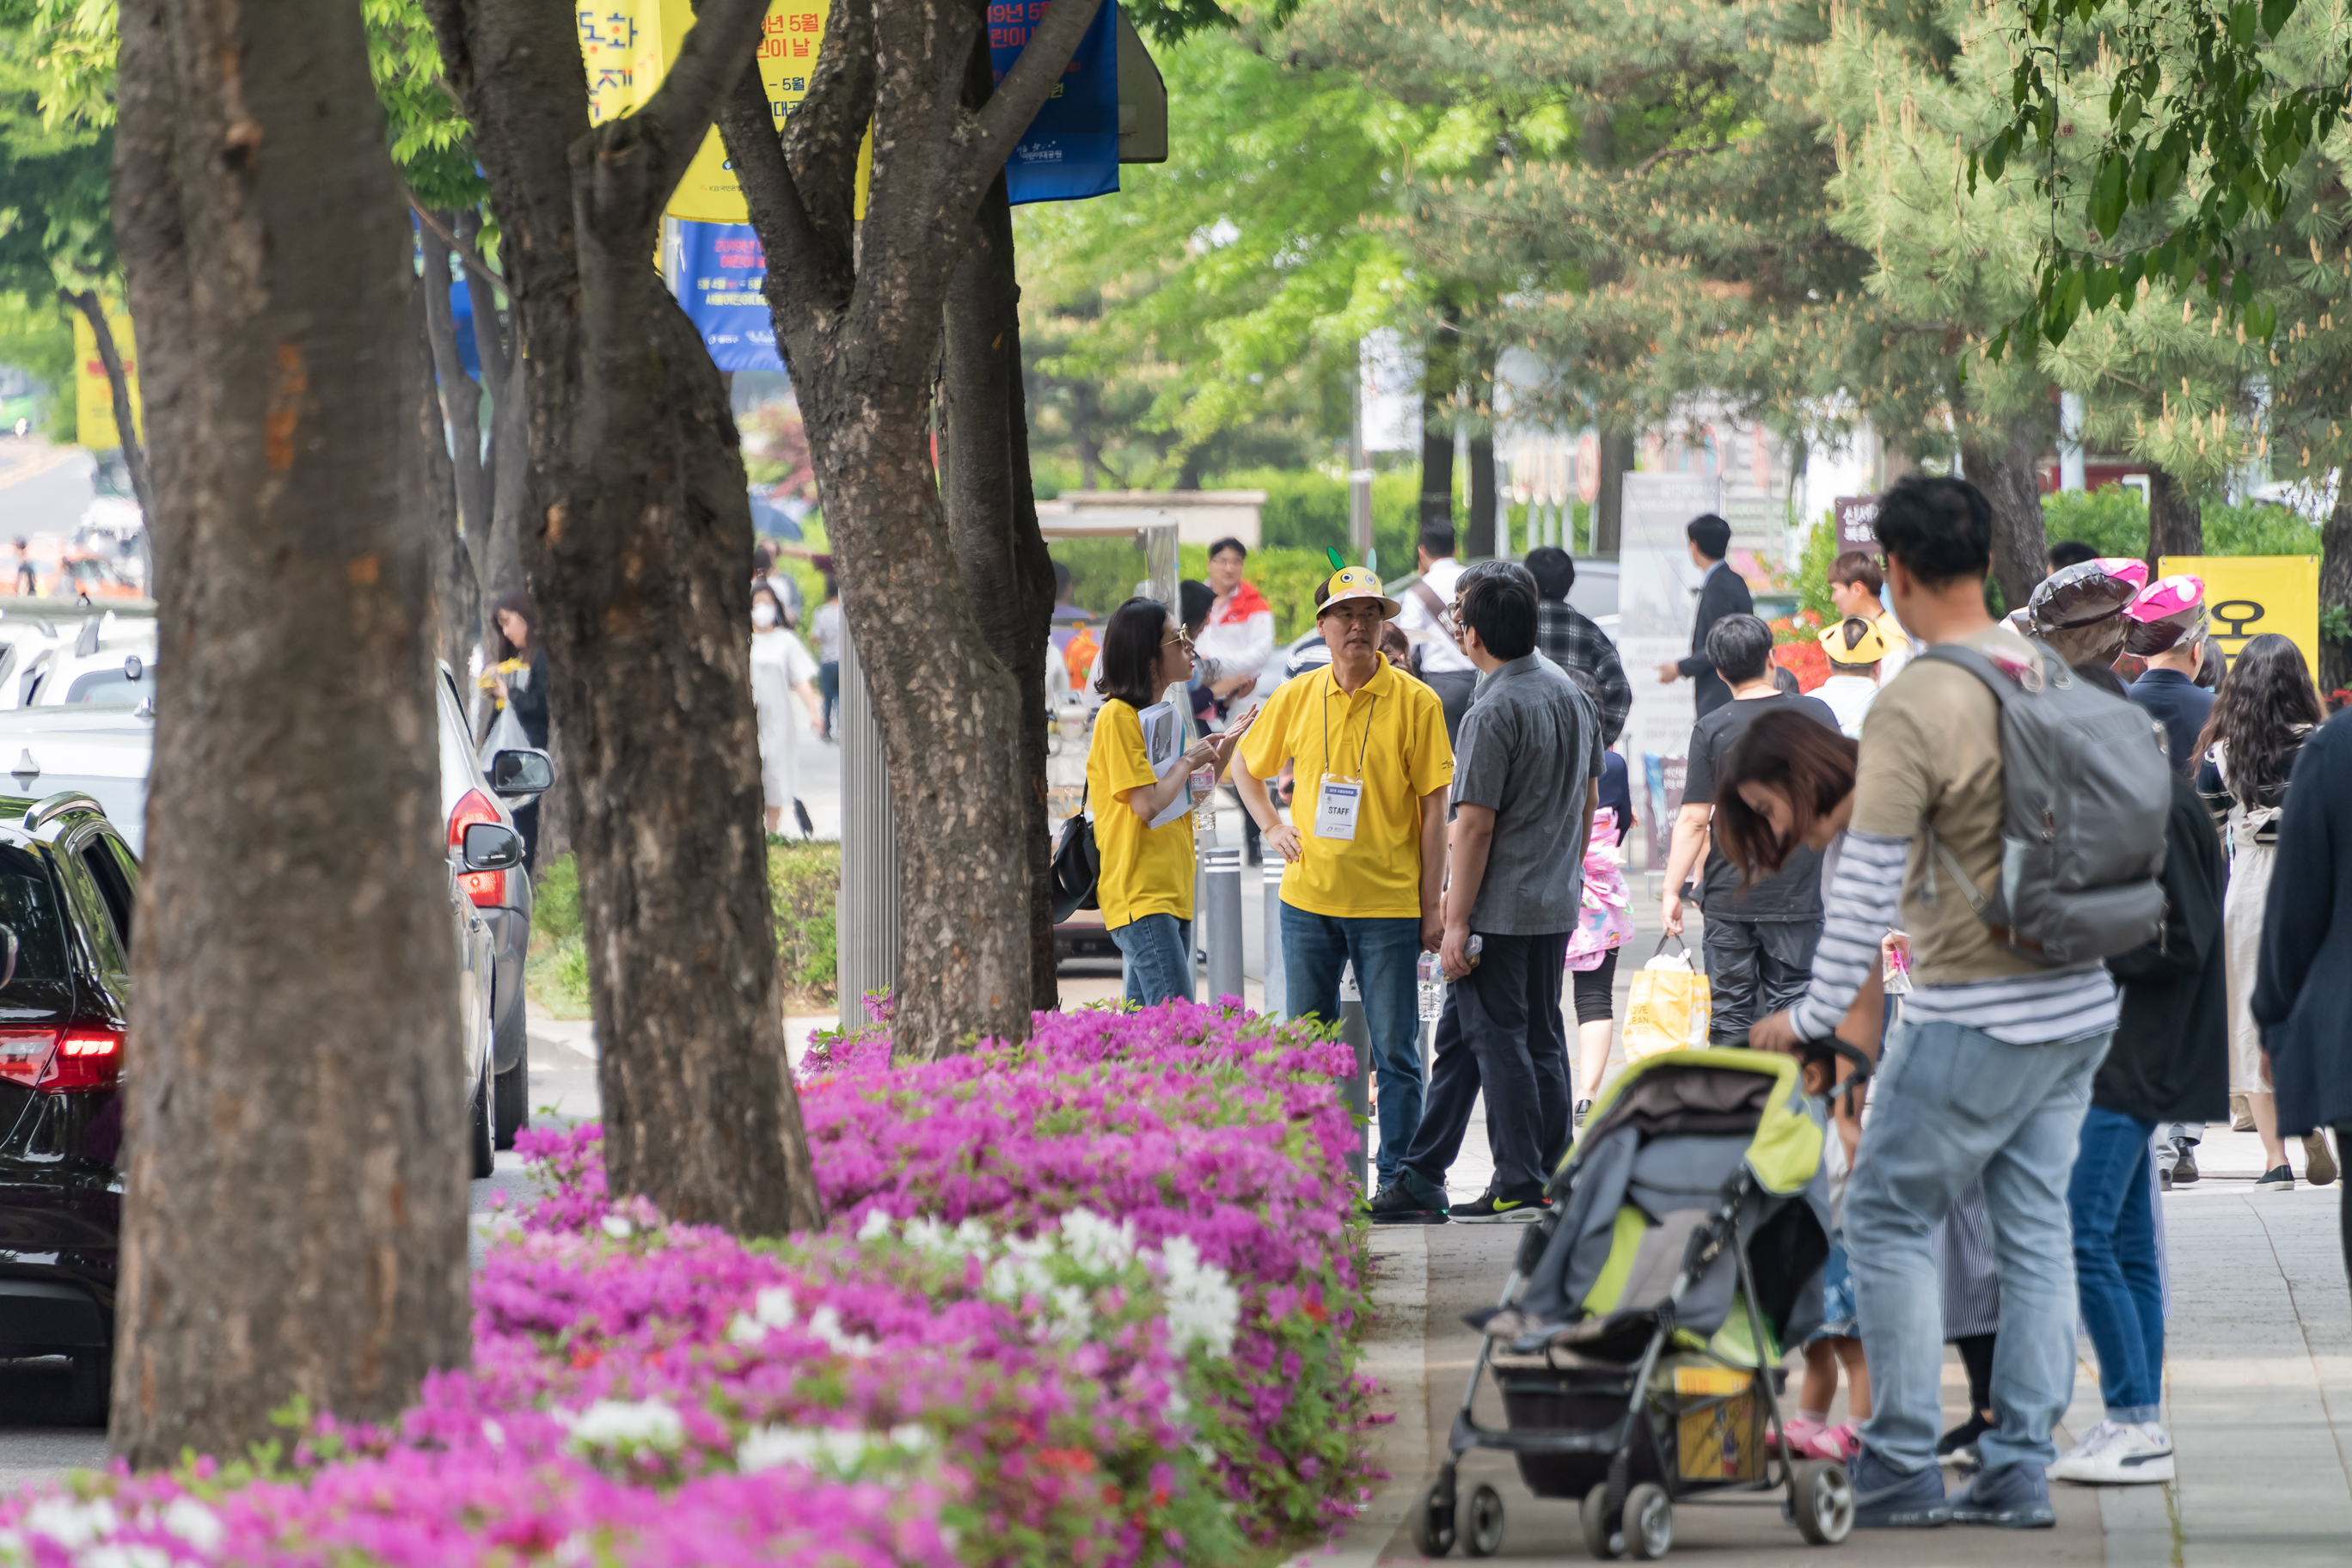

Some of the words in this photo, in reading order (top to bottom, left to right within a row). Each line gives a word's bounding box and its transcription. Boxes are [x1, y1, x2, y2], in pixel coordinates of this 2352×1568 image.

[789, 13, 819, 33] 5월
[988, 3, 1023, 23] 19년
[793, 37, 811, 58] 날
[990, 27, 1026, 48] 린이
[782, 77, 805, 92] 5월
[1327, 806, 1350, 816] STAFF
